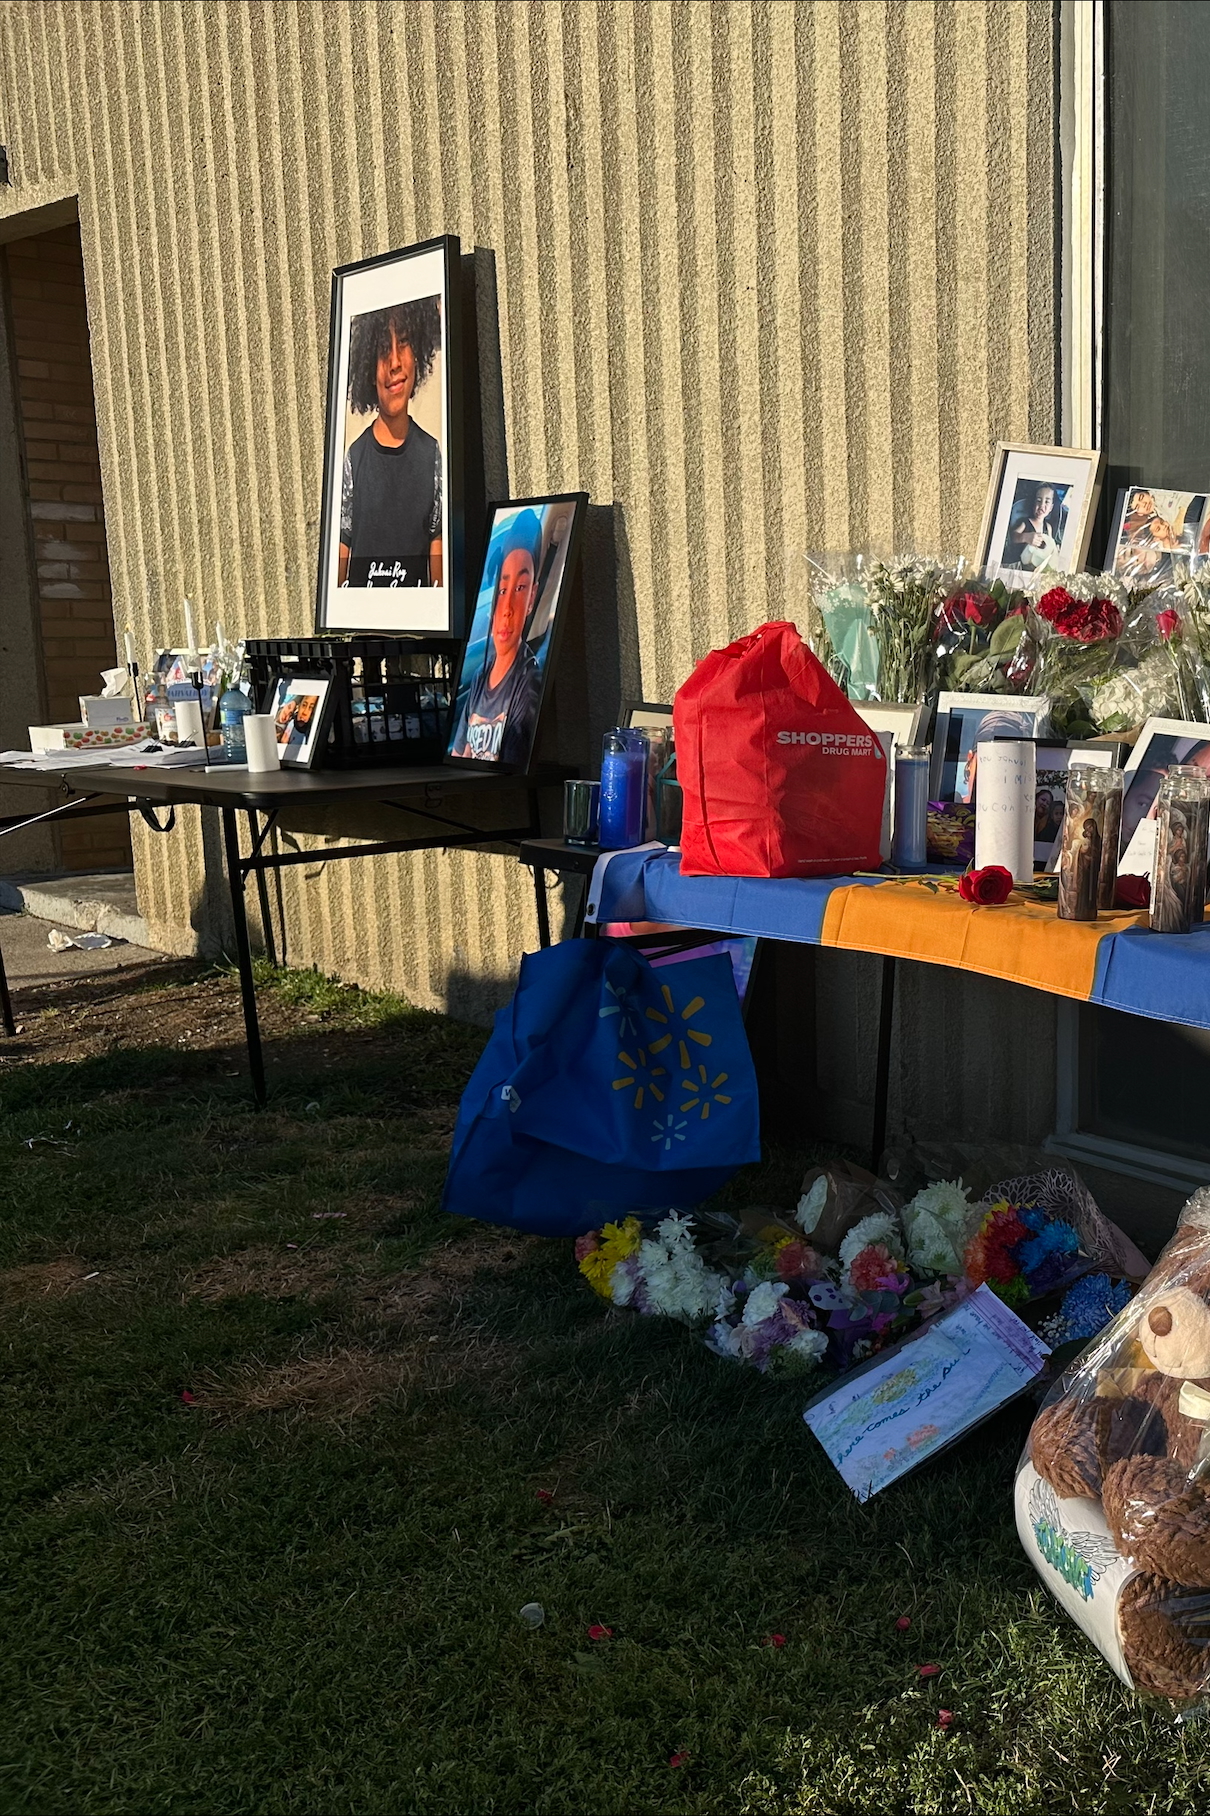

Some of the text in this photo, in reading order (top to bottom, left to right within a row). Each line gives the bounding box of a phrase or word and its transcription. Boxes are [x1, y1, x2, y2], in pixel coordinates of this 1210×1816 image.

[776, 731, 873, 748] SHOPPERS
[822, 747, 872, 756] DRUG MART
[836, 1435, 865, 1467] here
[916, 1381, 942, 1407] the
